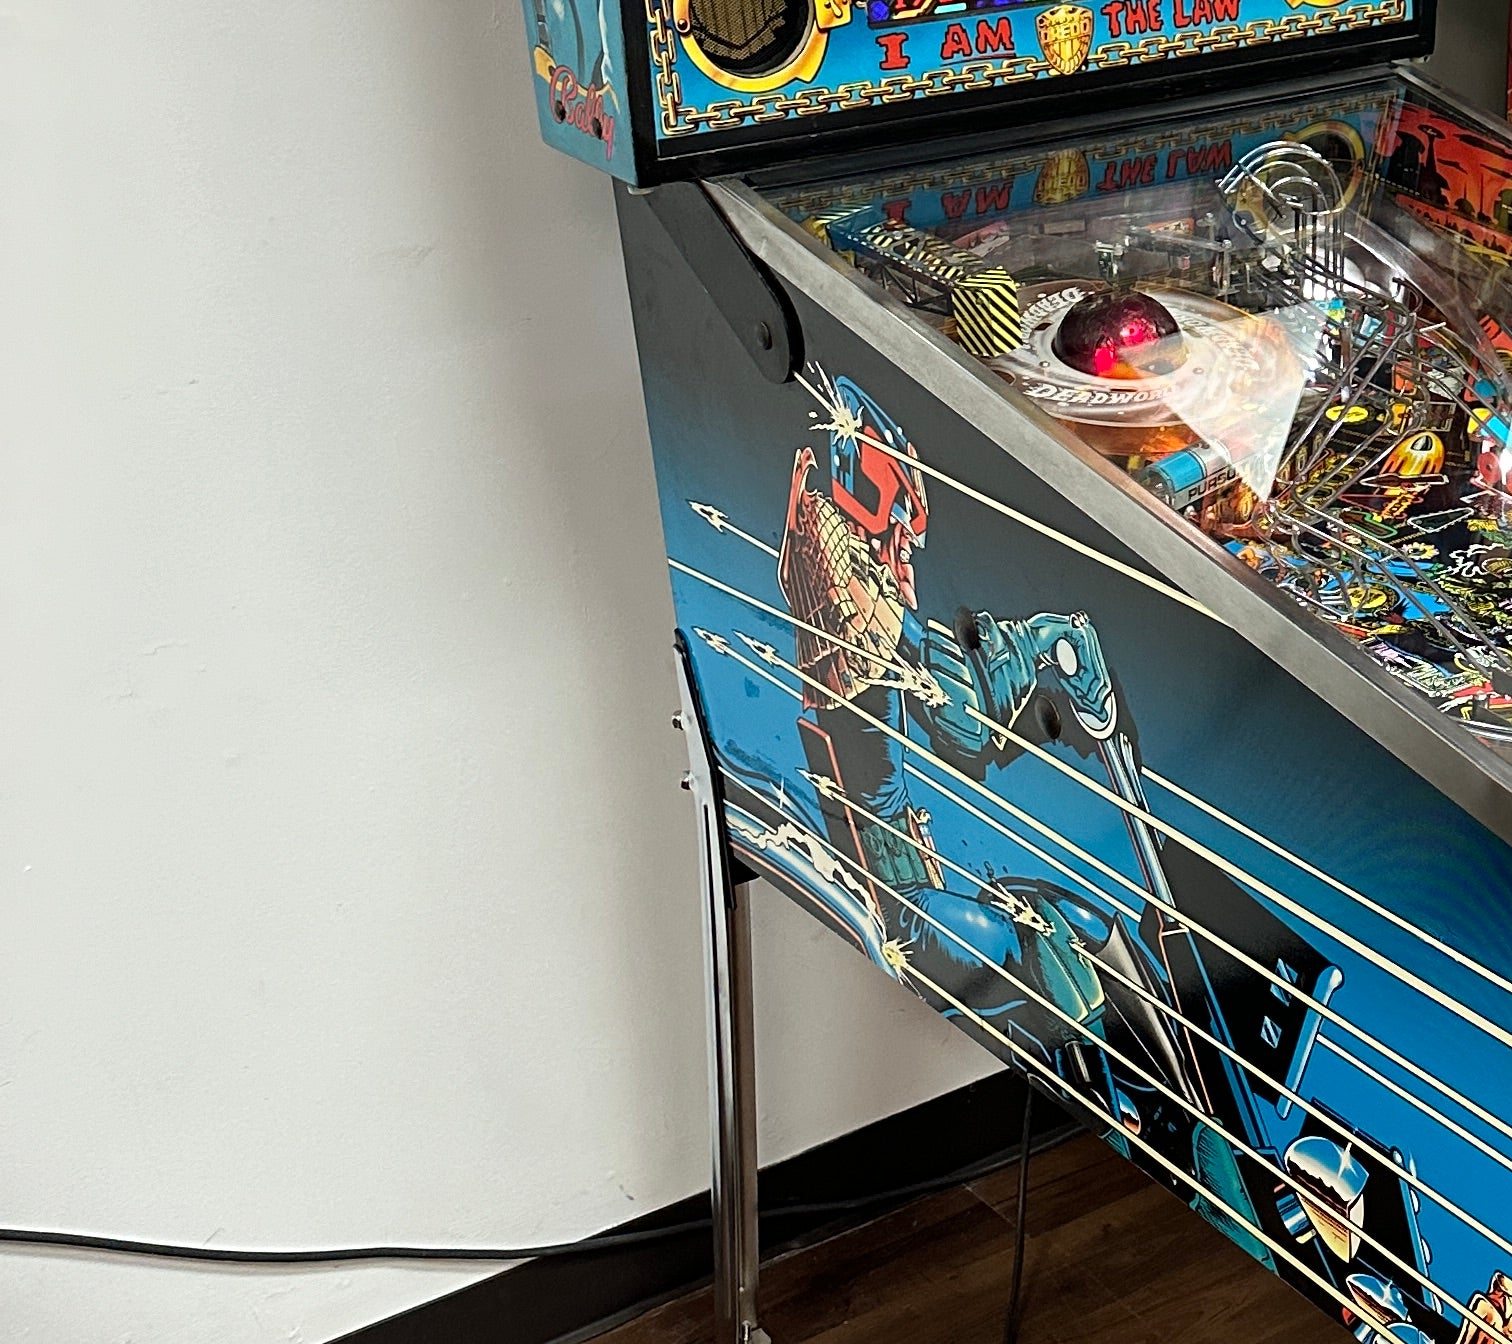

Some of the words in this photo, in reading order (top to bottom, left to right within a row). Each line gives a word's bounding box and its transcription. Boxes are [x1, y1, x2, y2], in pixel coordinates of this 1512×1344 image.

[877, 33, 911, 71] I
[940, 16, 1016, 61] AM
[548, 64, 616, 162] Bally
[1188, 466, 1237, 500] PURSU
